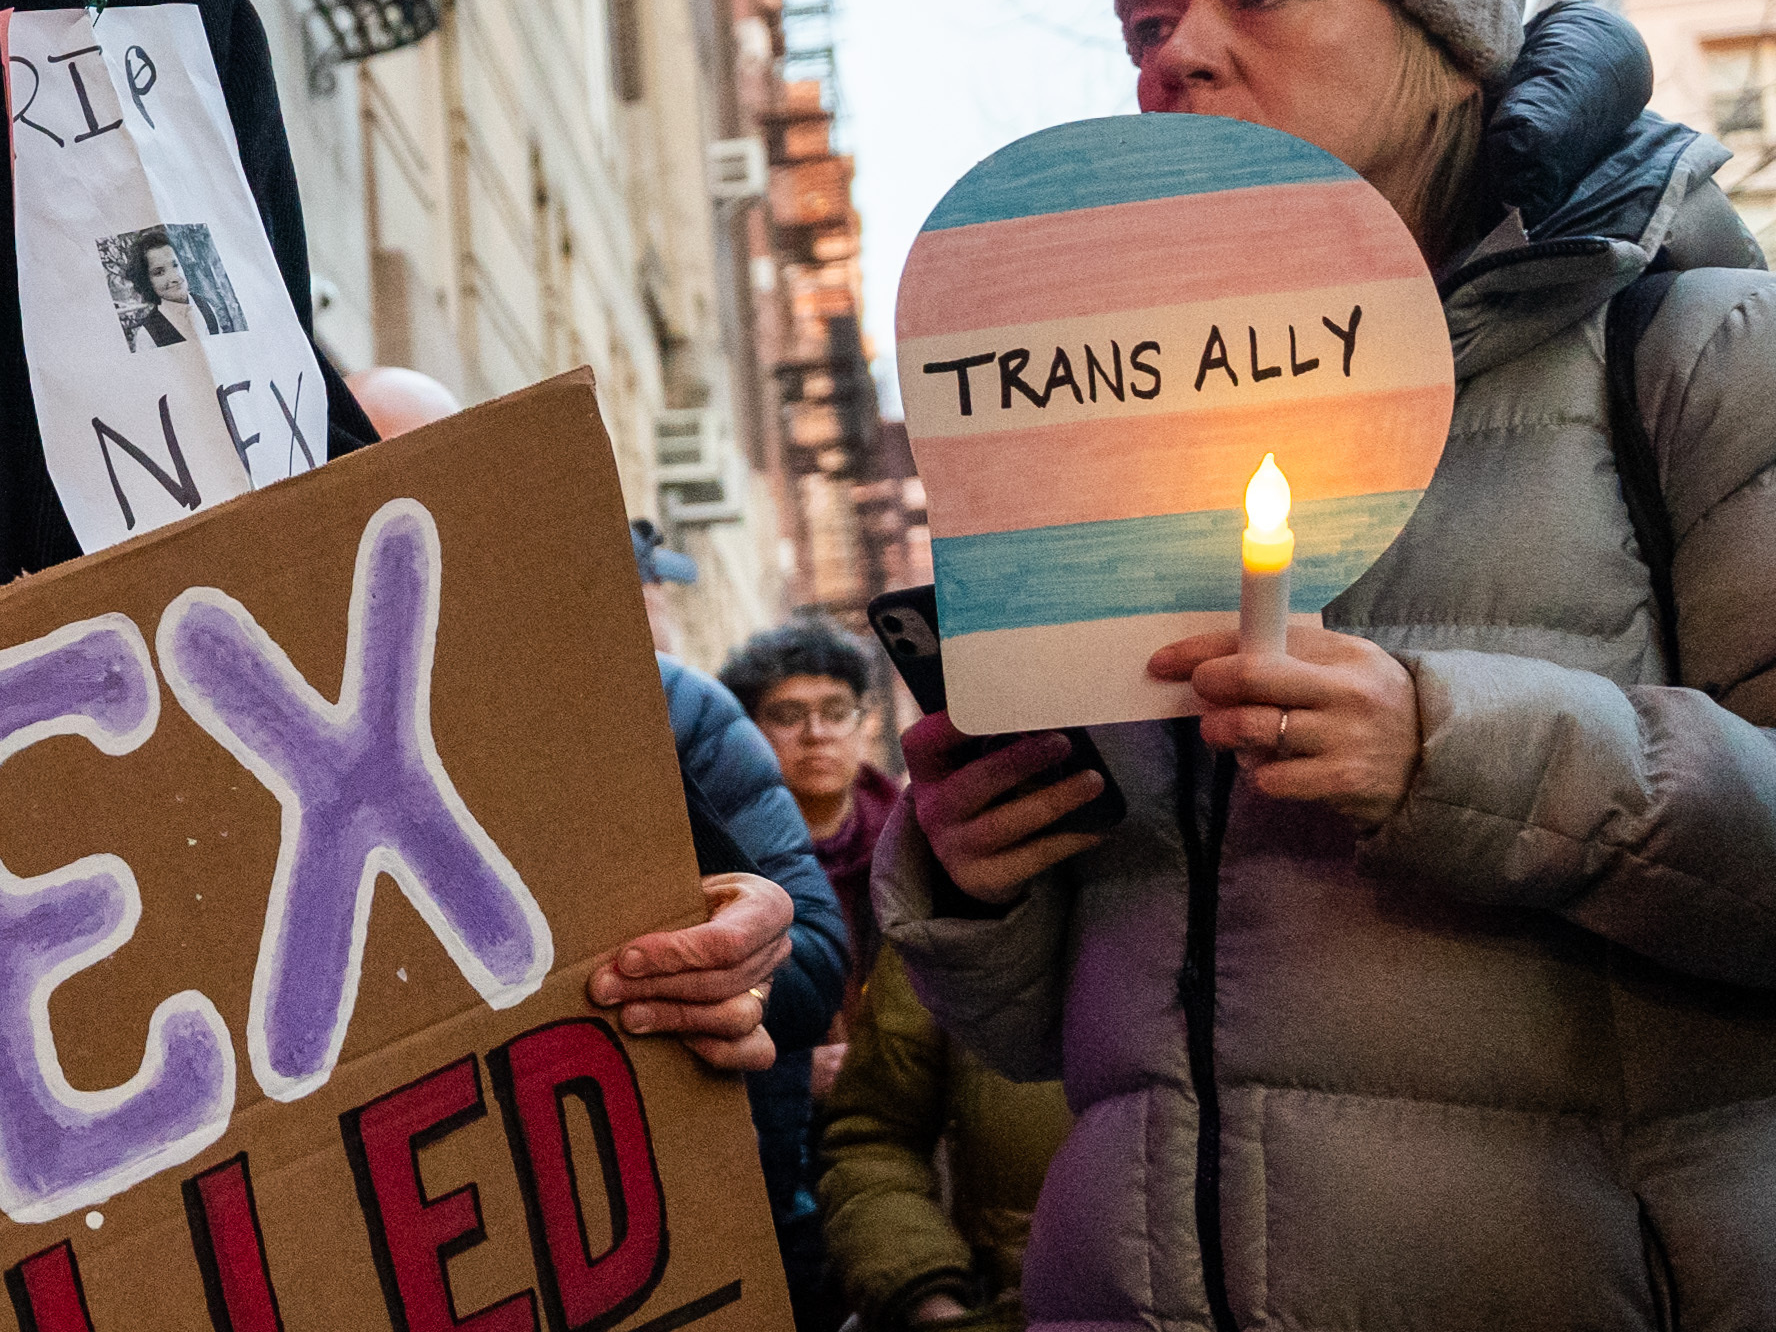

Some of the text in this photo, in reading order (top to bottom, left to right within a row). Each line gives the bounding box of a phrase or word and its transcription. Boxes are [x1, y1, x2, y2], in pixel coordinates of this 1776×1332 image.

[8, 44, 157, 147] RIP
[923, 305, 1363, 417] TRANS ALLY
